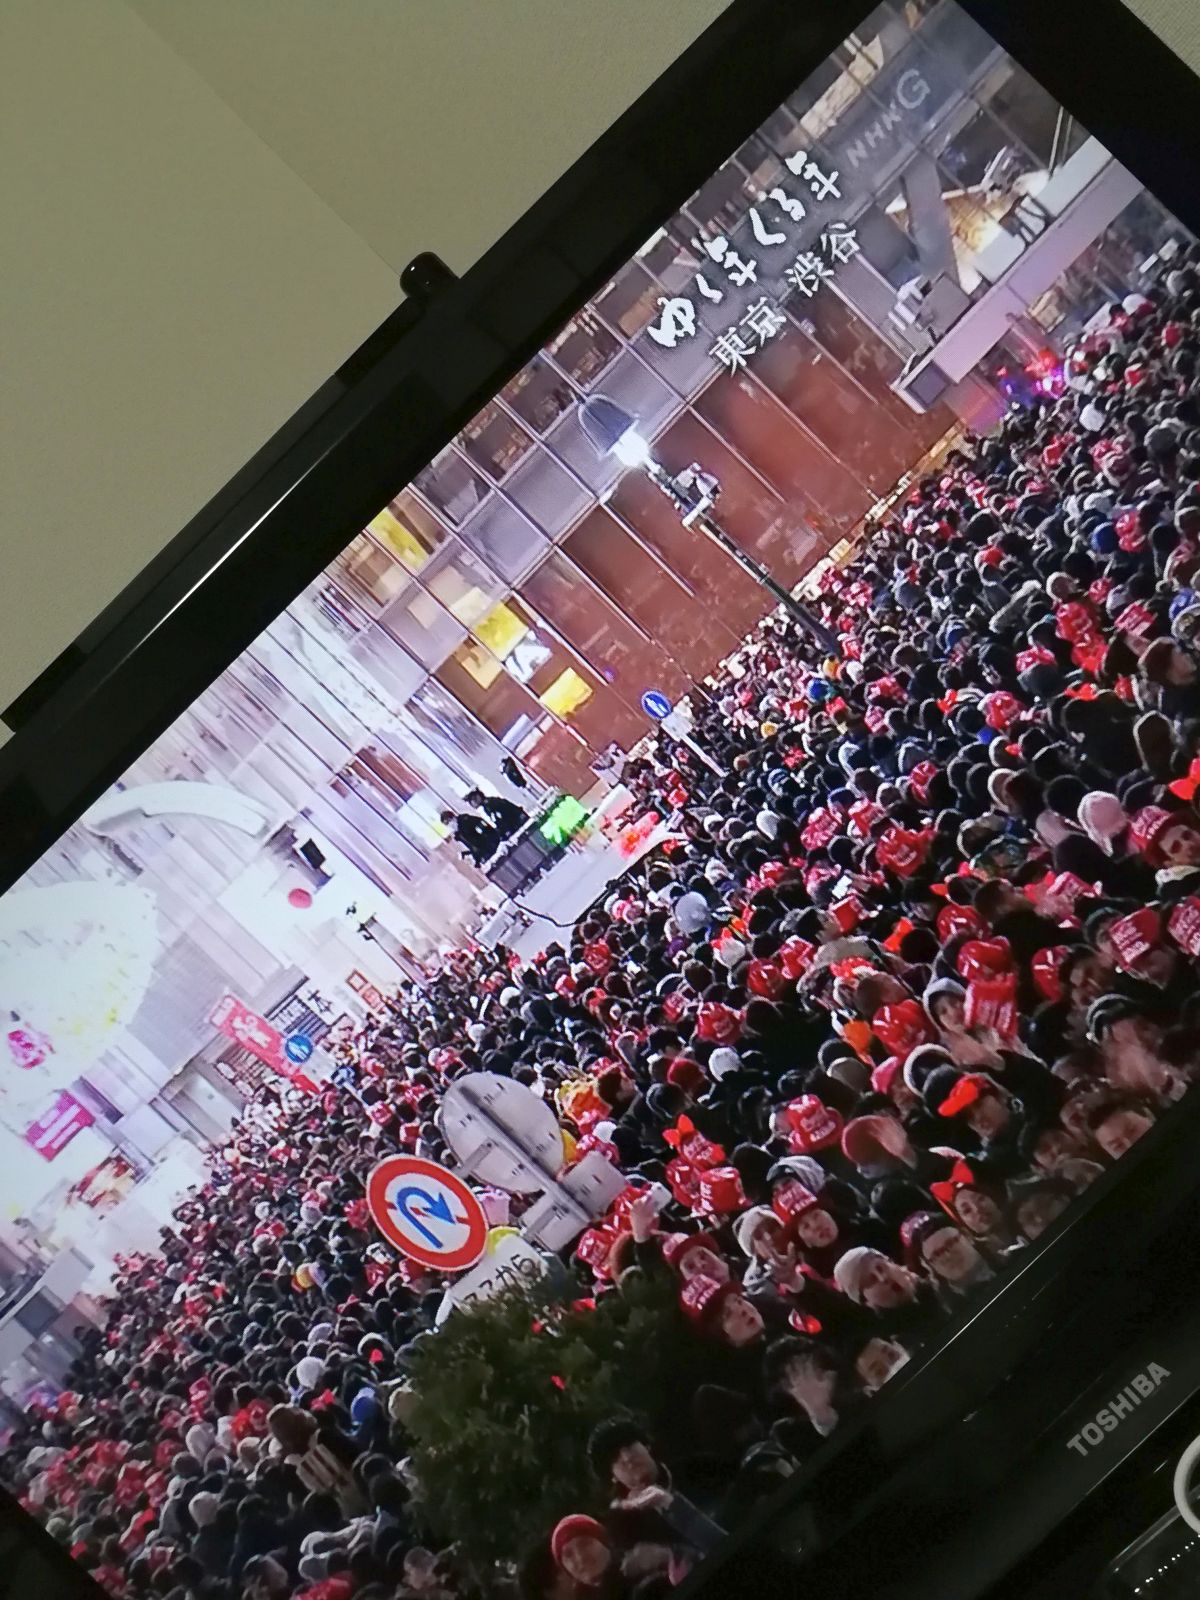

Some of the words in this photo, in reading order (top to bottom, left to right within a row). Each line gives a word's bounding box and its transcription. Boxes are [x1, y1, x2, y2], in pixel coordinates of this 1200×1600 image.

[647, 150, 841, 347] ゆく年くる年
[709, 297, 787, 377] 東京
[784, 222, 860, 297] 渋谷
[1066, 1362, 1171, 1456] TOSHIBA
